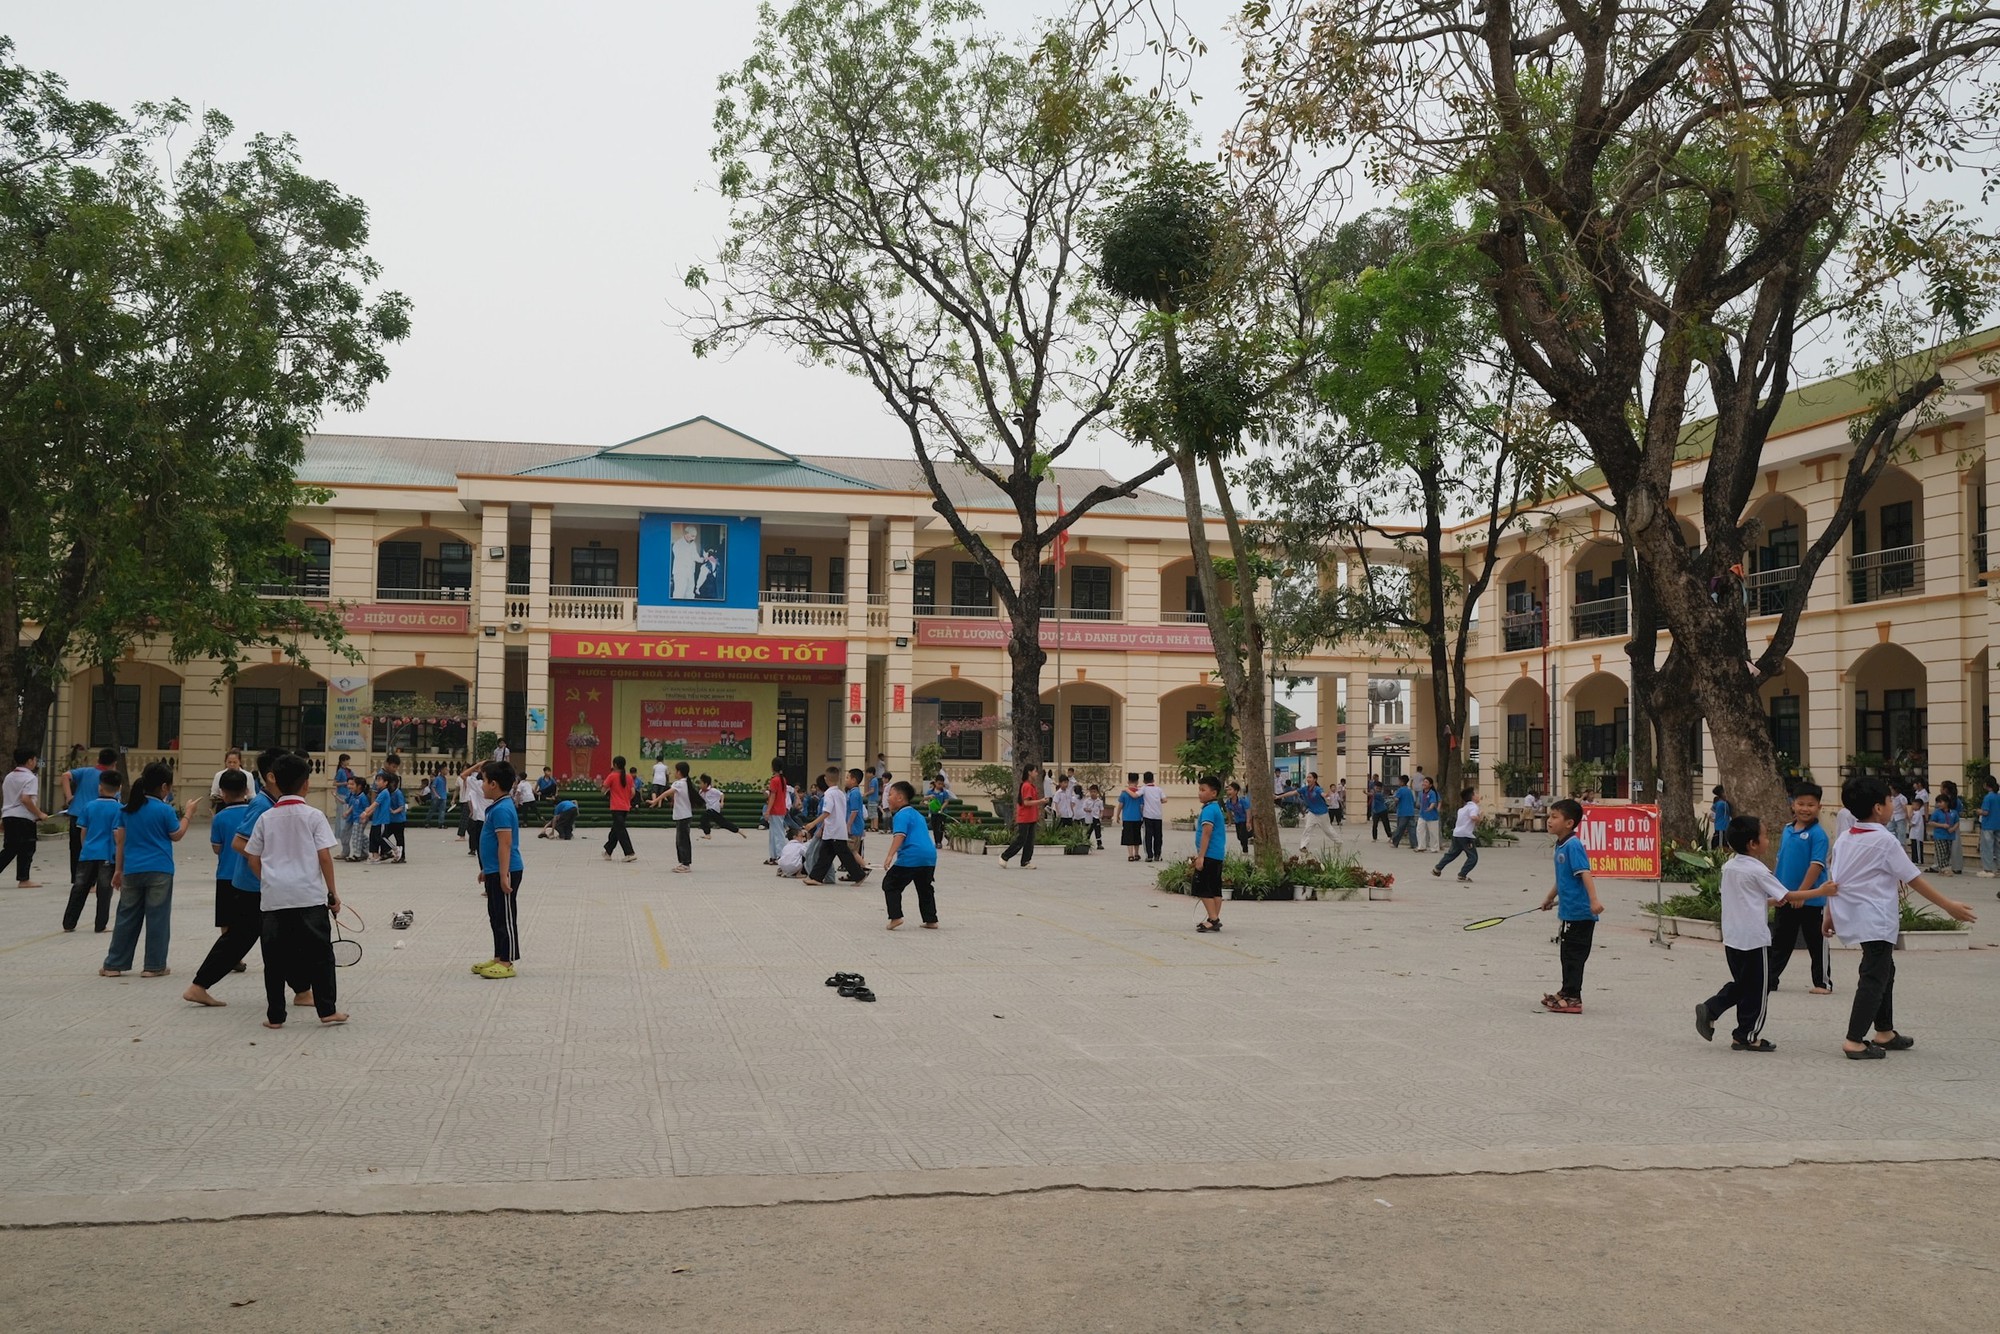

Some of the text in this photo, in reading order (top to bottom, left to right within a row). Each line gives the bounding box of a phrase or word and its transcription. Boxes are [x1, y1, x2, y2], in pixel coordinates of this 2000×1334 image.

[364, 612, 396, 625] HIỆU
[399, 612, 426, 625] QUẢ
[429, 615, 457, 626] CAO
[928, 626, 960, 639] CHẤT
[962, 628, 1004, 640] LƯỢNG
[1039, 631, 1064, 644] DỤC
[1067, 630, 1082, 642] LÀ
[1085, 632, 1117, 643] DANH
[1120, 633, 1138, 645] DỰ
[1139, 632, 1164, 644] CỦA
[1166, 634, 1190, 645] NHÀ
[577, 641, 630, 658] DẠY
[639, 638, 690, 657] TỐT
[717, 645, 770, 662] HỌC
[778, 642, 828, 661] TỐT
[577, 668, 607, 677] NƯỚC
[610, 668, 640, 678] CỘNG
[666, 670, 680, 679] XÃ
[683, 671, 700, 680] HỘI
[704, 671, 725, 679] CHỦ
[728, 672, 760, 680] NGHĨA
[763, 672, 784, 681] VIỆT
[674, 706, 720, 717] NGÀY HỘI
[1574, 810, 1607, 851] ẤM
[1615, 819, 1625, 832] ĐI
[1628, 816, 1635, 832] Ô
[1637, 816, 1650, 832] TÔ
[1613, 838, 1622, 851] ĐI
[1624, 837, 1634, 851] XE
[1637, 835, 1654, 851] MÁY
[1600, 855, 1617, 871] SÂN
[1620, 855, 1653, 872] TRƯỜNG
